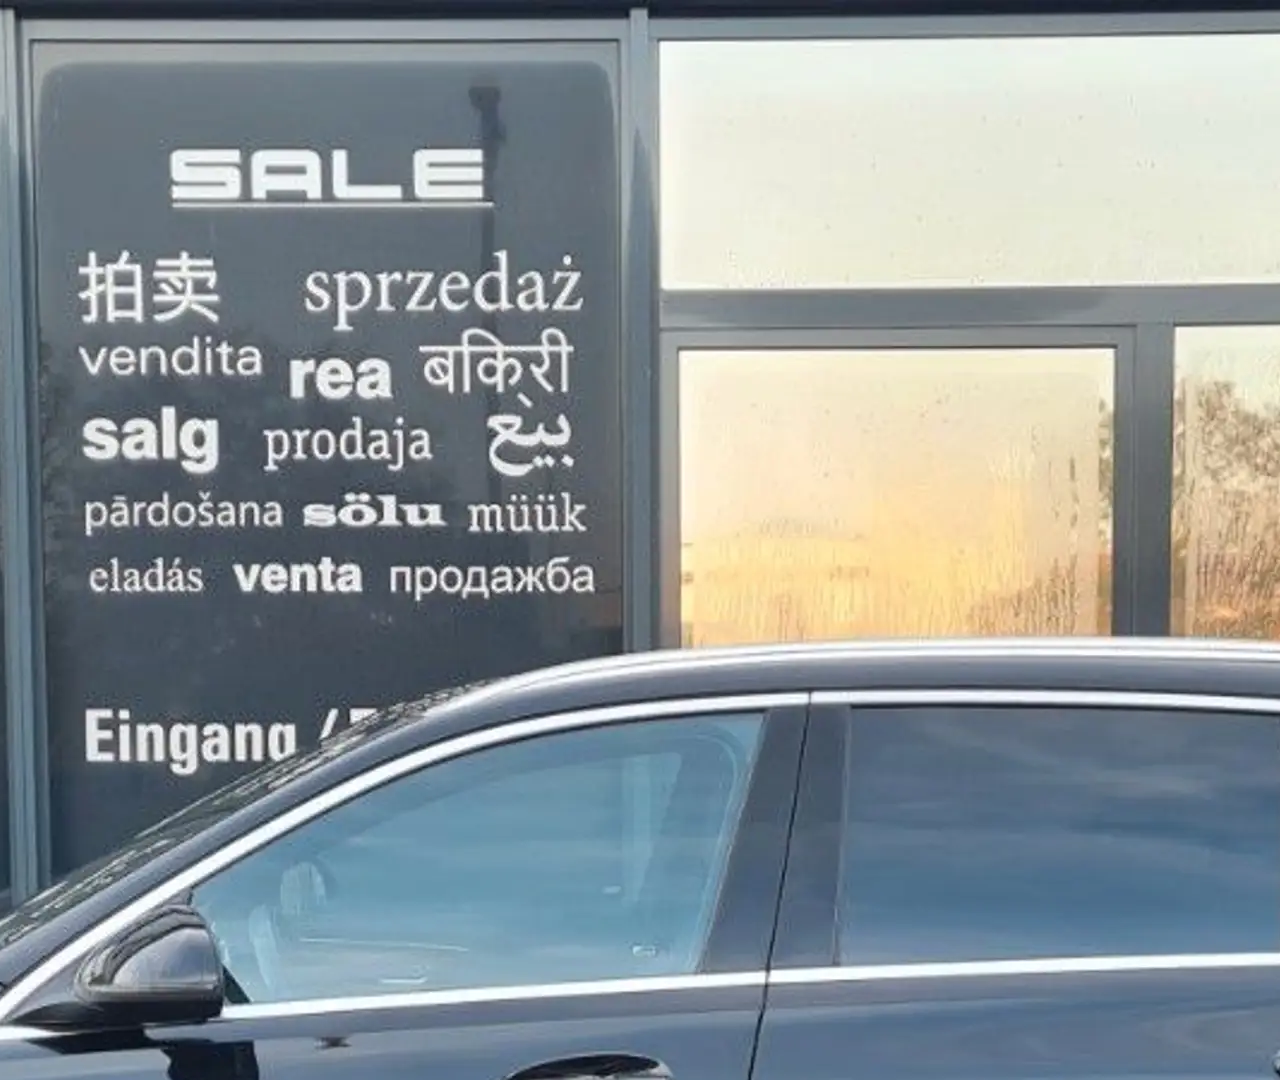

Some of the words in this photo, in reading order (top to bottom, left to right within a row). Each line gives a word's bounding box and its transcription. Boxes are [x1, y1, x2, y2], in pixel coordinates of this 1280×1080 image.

[171, 149, 483, 199] SALE
[78, 250, 219, 323] 拍卖
[305, 249, 584, 330] sprzedaż
[79, 335, 262, 376] vendita
[290, 358, 392, 400] rea
[83, 406, 219, 474] salg
[263, 416, 433, 471] prodaja
[487, 414, 574, 477] بيع
[85, 491, 283, 536] pārdošana
[303, 492, 446, 527] sölu
[468, 492, 587, 532] müük
[89, 557, 204, 593] eladás
[233, 557, 363, 593] venta
[390, 556, 595, 602] продажба
